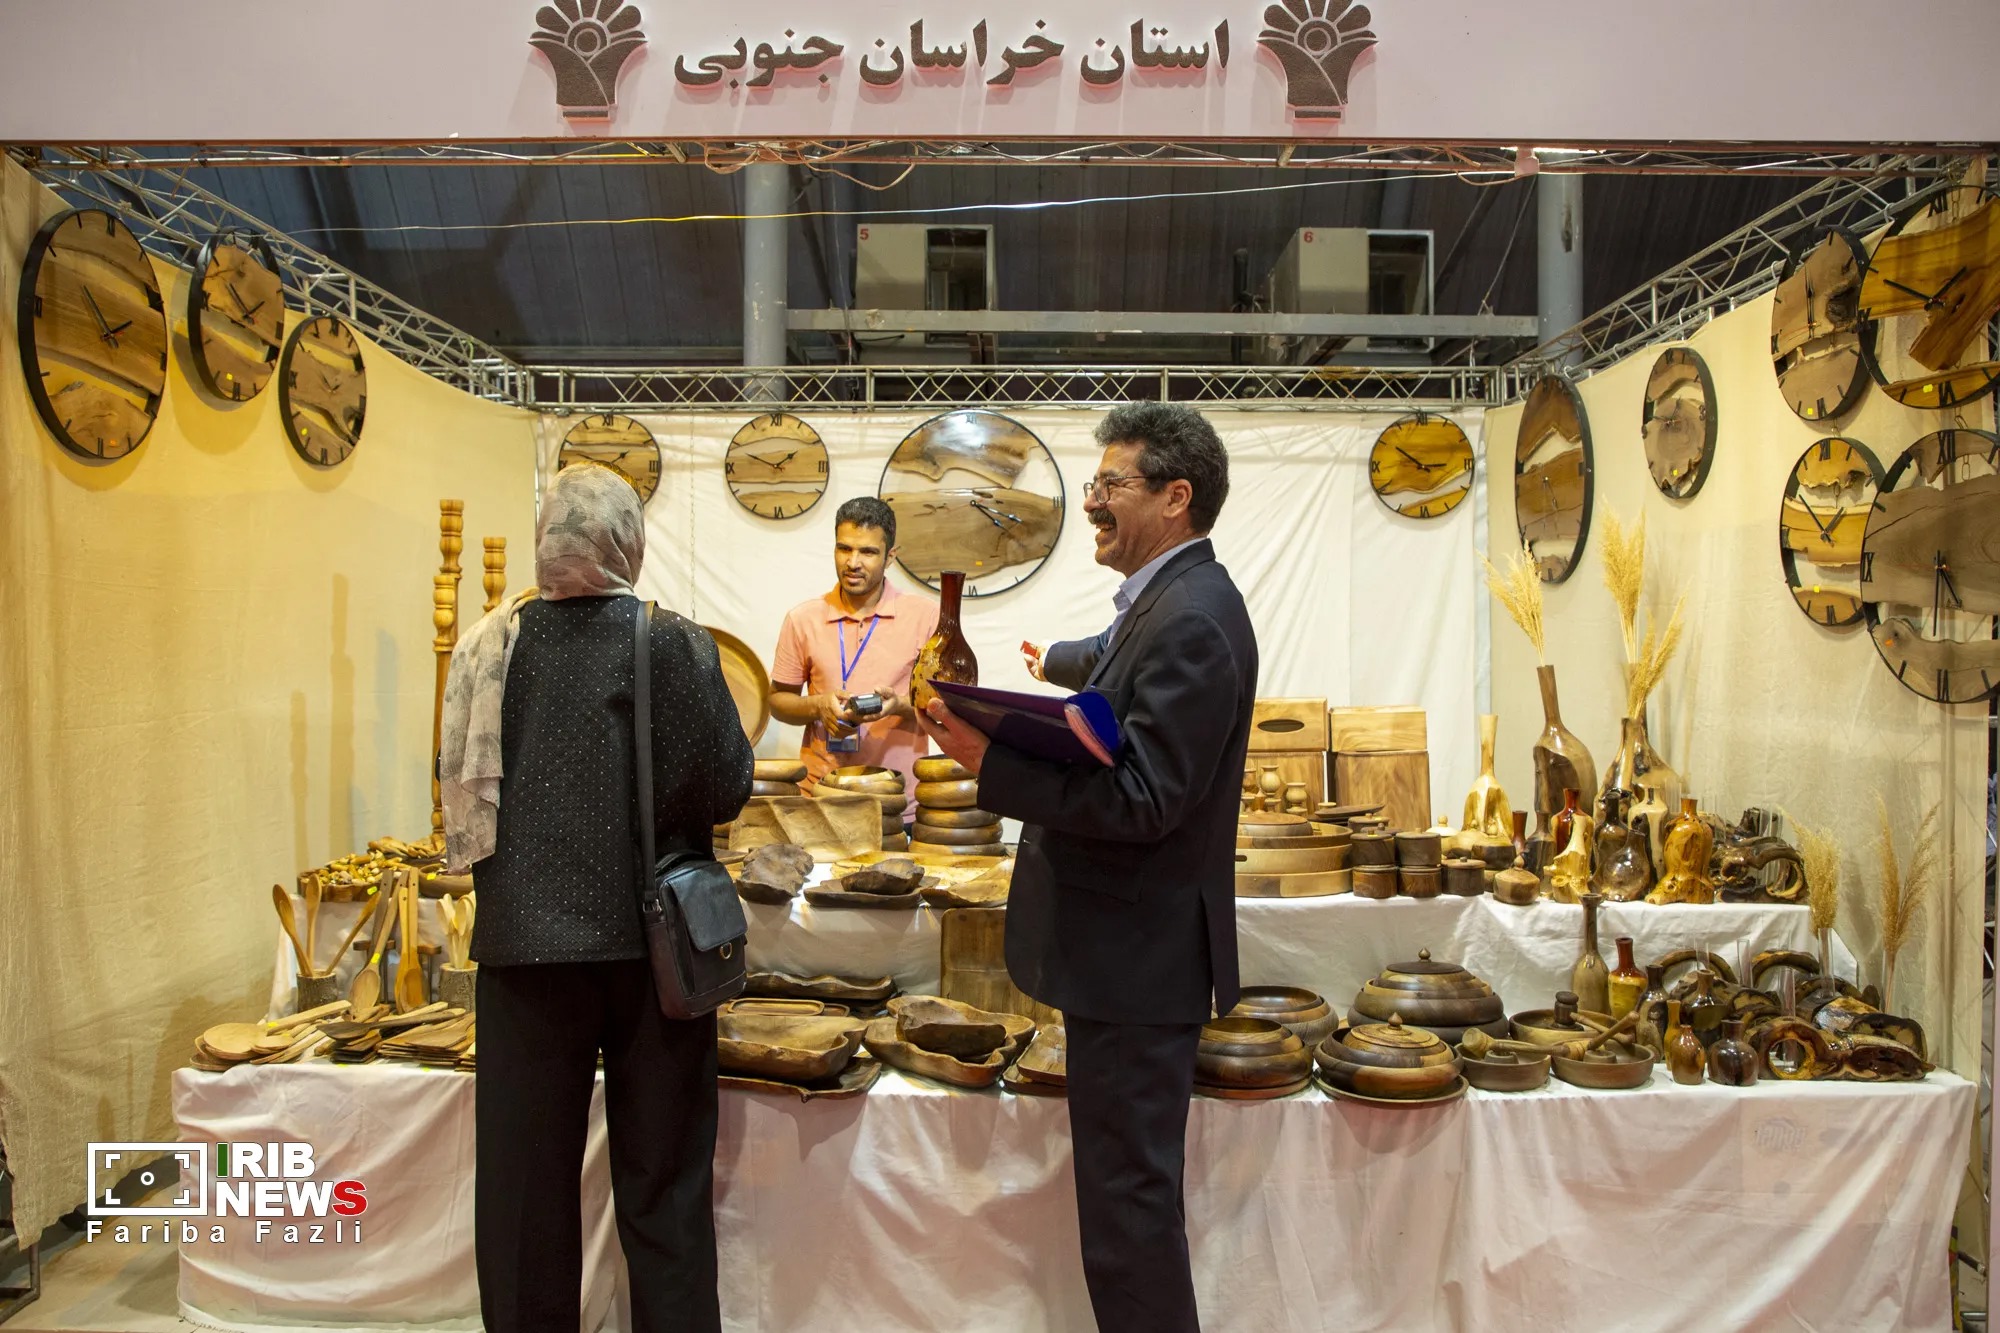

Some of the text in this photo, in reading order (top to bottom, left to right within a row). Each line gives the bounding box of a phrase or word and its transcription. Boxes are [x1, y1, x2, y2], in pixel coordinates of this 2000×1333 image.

[674, 18, 1229, 89] استان خراسان جنوبی
[859, 228, 869, 241] 5
[1303, 231, 1314, 243] 6
